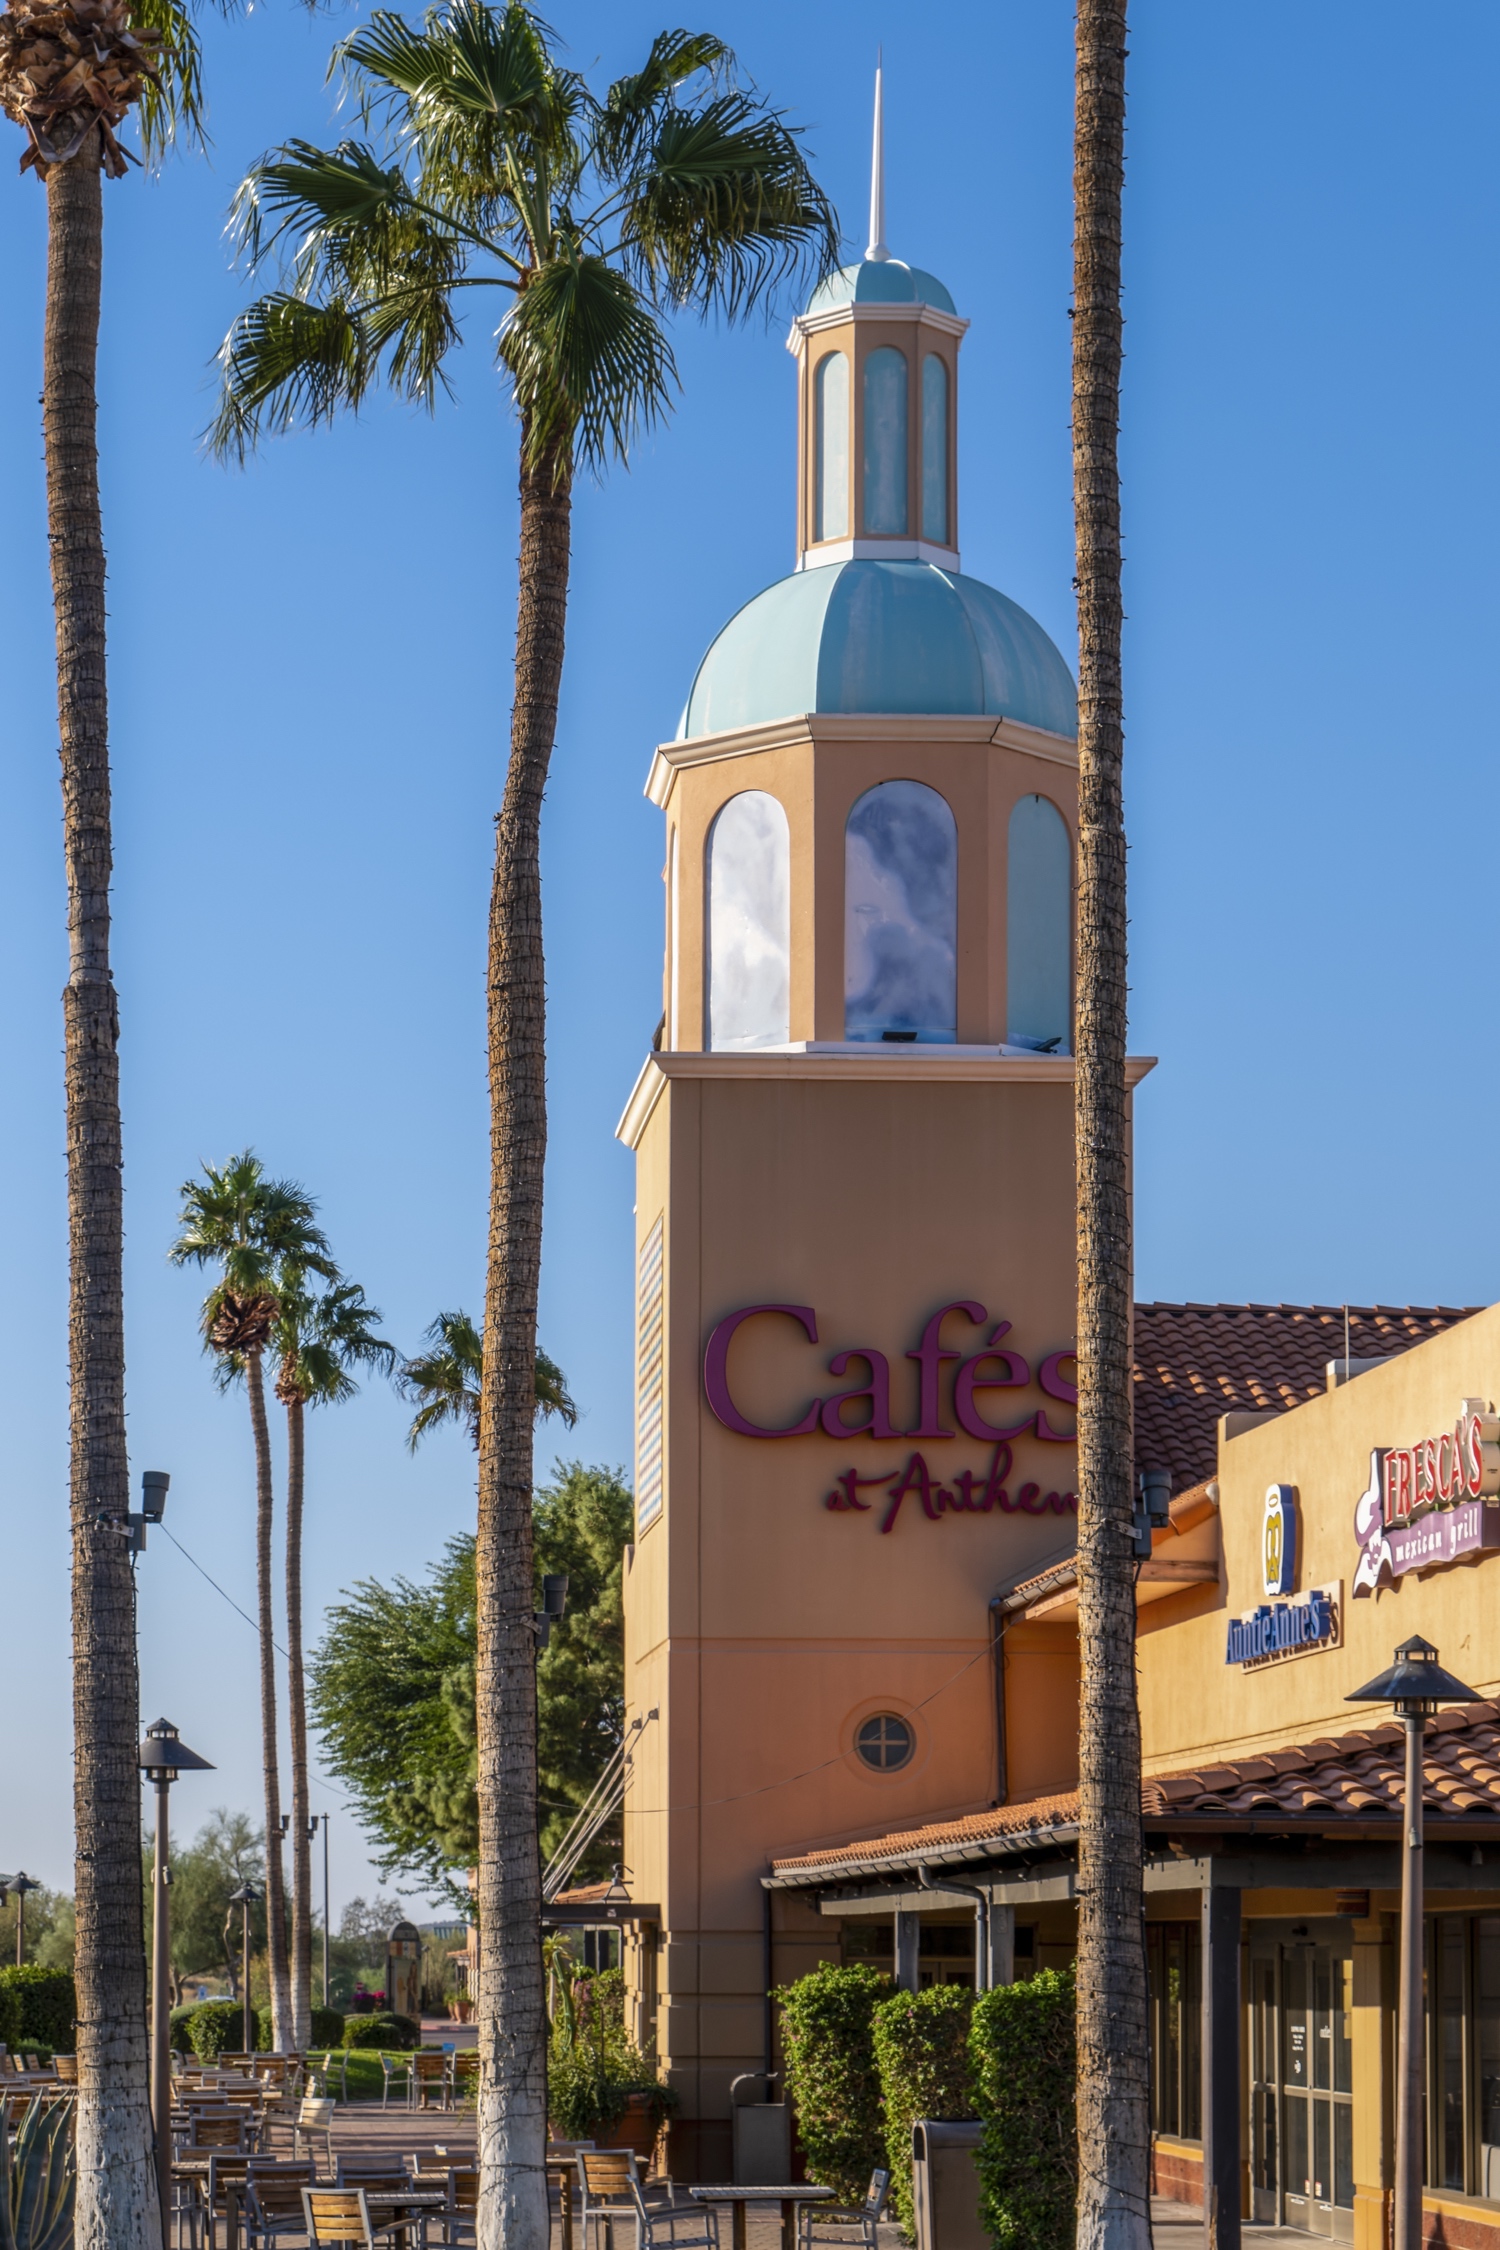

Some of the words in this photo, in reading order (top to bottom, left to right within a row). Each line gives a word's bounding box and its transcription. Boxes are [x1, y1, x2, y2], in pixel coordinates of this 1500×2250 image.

[704, 1301, 1078, 1442] Cafés
[825, 1468, 899, 1511] at
[1383, 1399, 1484, 1527] FRESCA'S
[1395, 1530, 1442, 1562] mexican
[1450, 1507, 1478, 1555] grill
